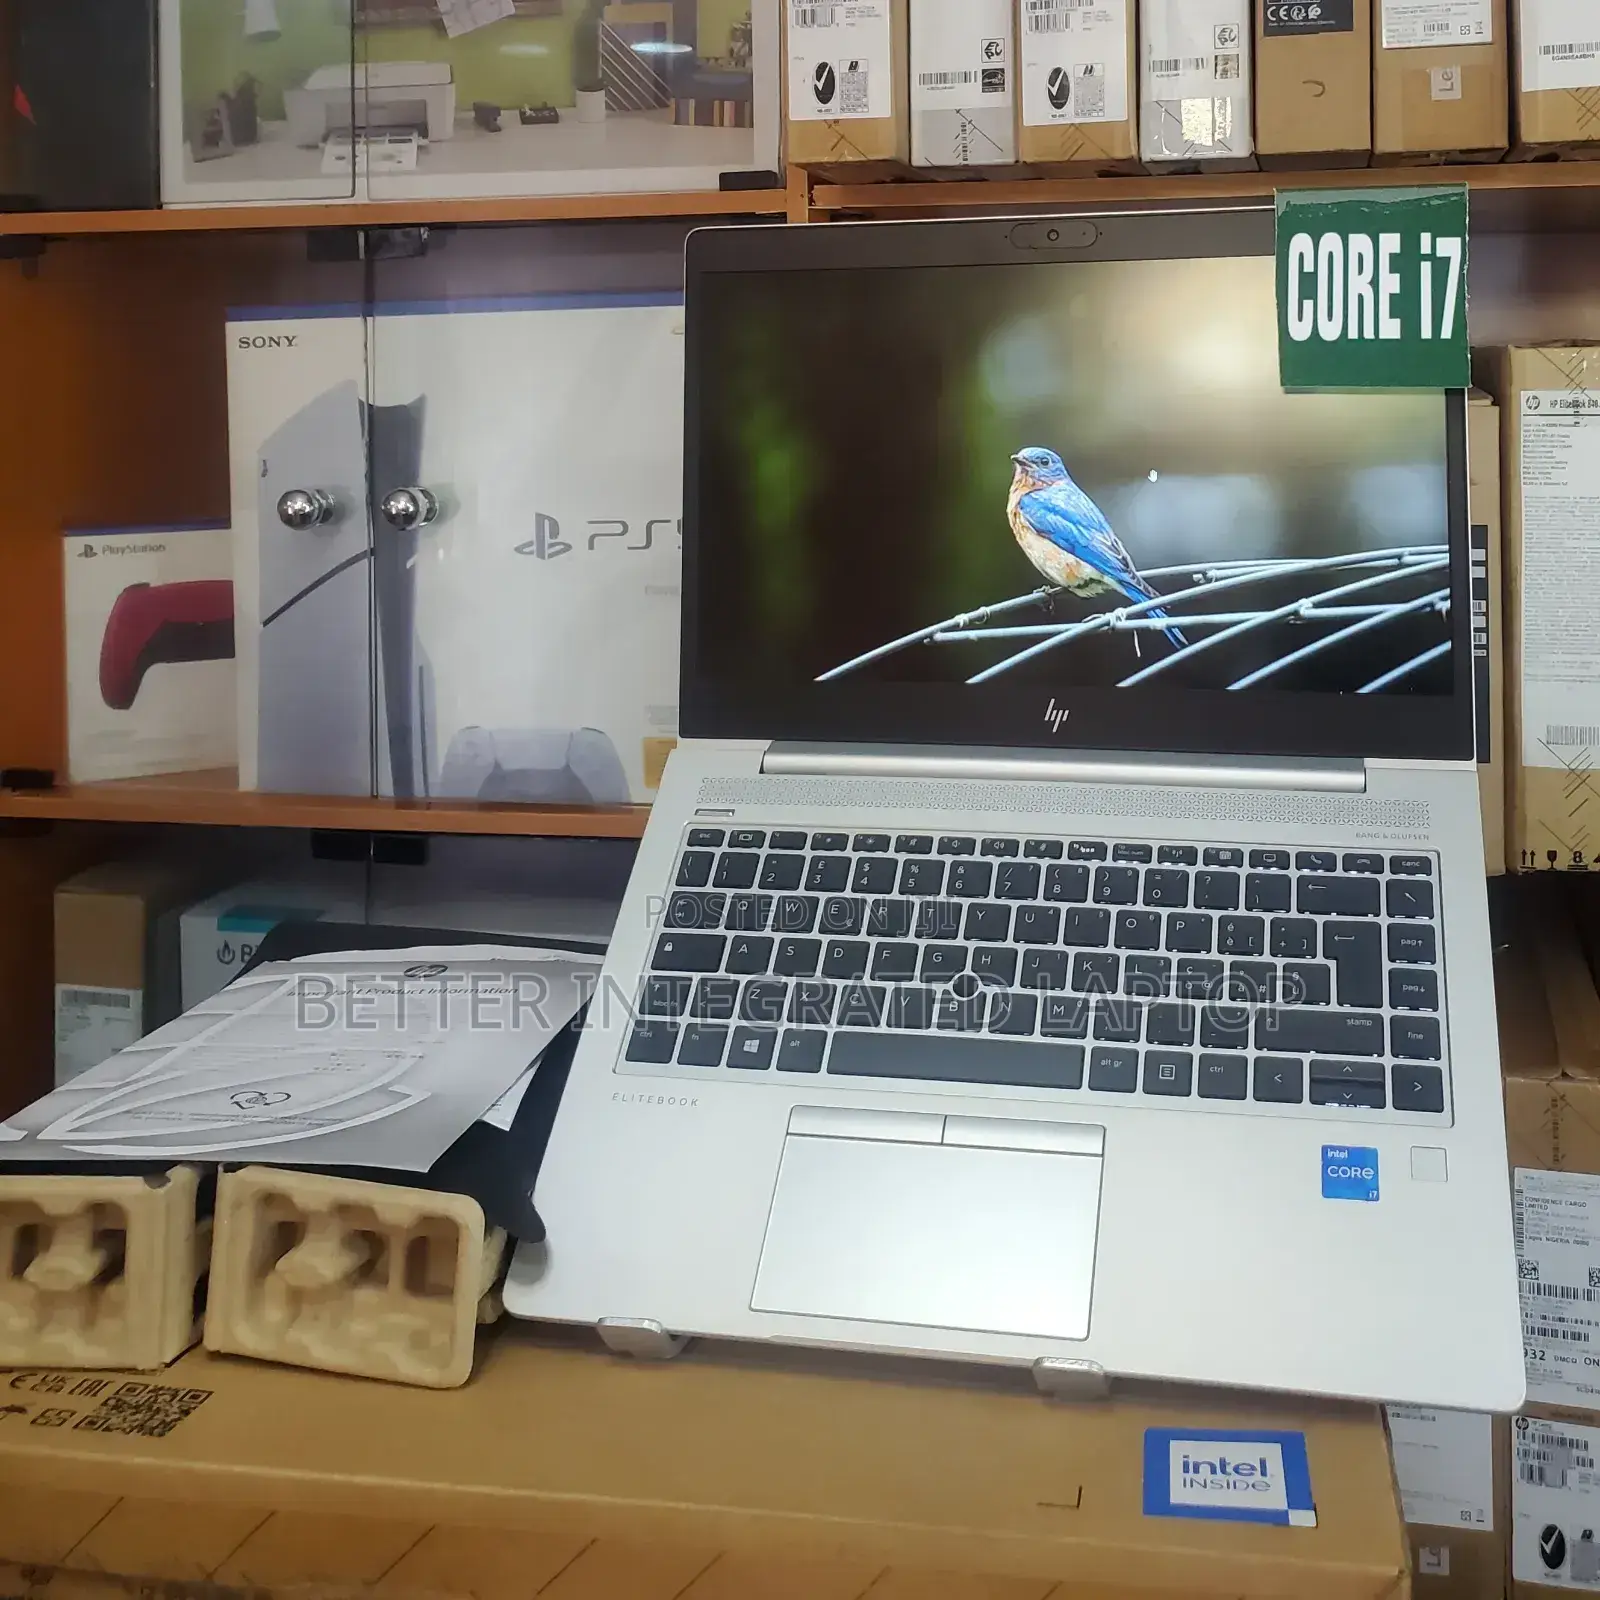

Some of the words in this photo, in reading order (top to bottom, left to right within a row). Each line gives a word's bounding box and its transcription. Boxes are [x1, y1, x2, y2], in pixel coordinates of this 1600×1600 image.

[1287, 232, 1401, 341] CORE
[1420, 232, 1462, 340] i7
[238, 336, 297, 349] SONY
[587, 519, 682, 551] PS
[102, 544, 166, 556] PlayStation
[1044, 698, 1070, 732] hp
[910, 865, 919, 874] %
[766, 872, 776, 882] 2
[813, 874, 822, 884] 3
[860, 876, 868, 886] 4
[908, 879, 916, 888] 5
[955, 880, 963, 889] 6
[1003, 882, 1012, 892] 7
[1053, 884, 1061, 894] 8
[1102, 886, 1111, 896] 9
[738, 900, 748, 911] Q
[785, 902, 799, 912] W
[830, 904, 840, 914] E
[878, 907, 888, 917] R
[927, 908, 936, 918] T
[976, 910, 986, 920] Y
[1025, 912, 1035, 923] U
[1125, 918, 1137, 928] O
[1176, 920, 1185, 931] P
[1400, 938, 1416, 947] pag
[738, 944, 748, 954] A
[786, 946, 795, 956] S
[834, 948, 844, 958] D
[882, 950, 891, 960] F
[932, 952, 942, 962] G
[981, 954, 992, 965] H
[1031, 958, 1040, 968] J
[1082, 960, 1093, 971] K
[1134, 964, 1142, 974] L
[366, 987, 426, 996] Product
[428, 987, 518, 995] Information
[1258, 984, 1266, 994] #
[1402, 984, 1418, 993] pag
[750, 989, 761, 999] Z
[800, 992, 810, 1002] X
[850, 994, 860, 1004] C
[900, 996, 910, 1006] V
[949, 1001, 958, 1012] B
[1000, 1002, 1010, 1012] N
[1052, 1004, 1065, 1016] M
[1346, 1018, 1373, 1027] stamp
[692, 1033, 700, 1041] fn
[1408, 1032, 1424, 1040] fine
[1100, 1058, 1112, 1066] alt
[1113, 1059, 1122, 1068] gr
[1209, 1065, 1224, 1074] ctrl
[612, 1092, 700, 1107] ELITEBOOK
[1327, 1148, 1348, 1158] intel
[1369, 1190, 1378, 1198] i7
[1525, 1196, 1562, 1206] CONFIDENCE
[1182, 1455, 1268, 1478] intel
